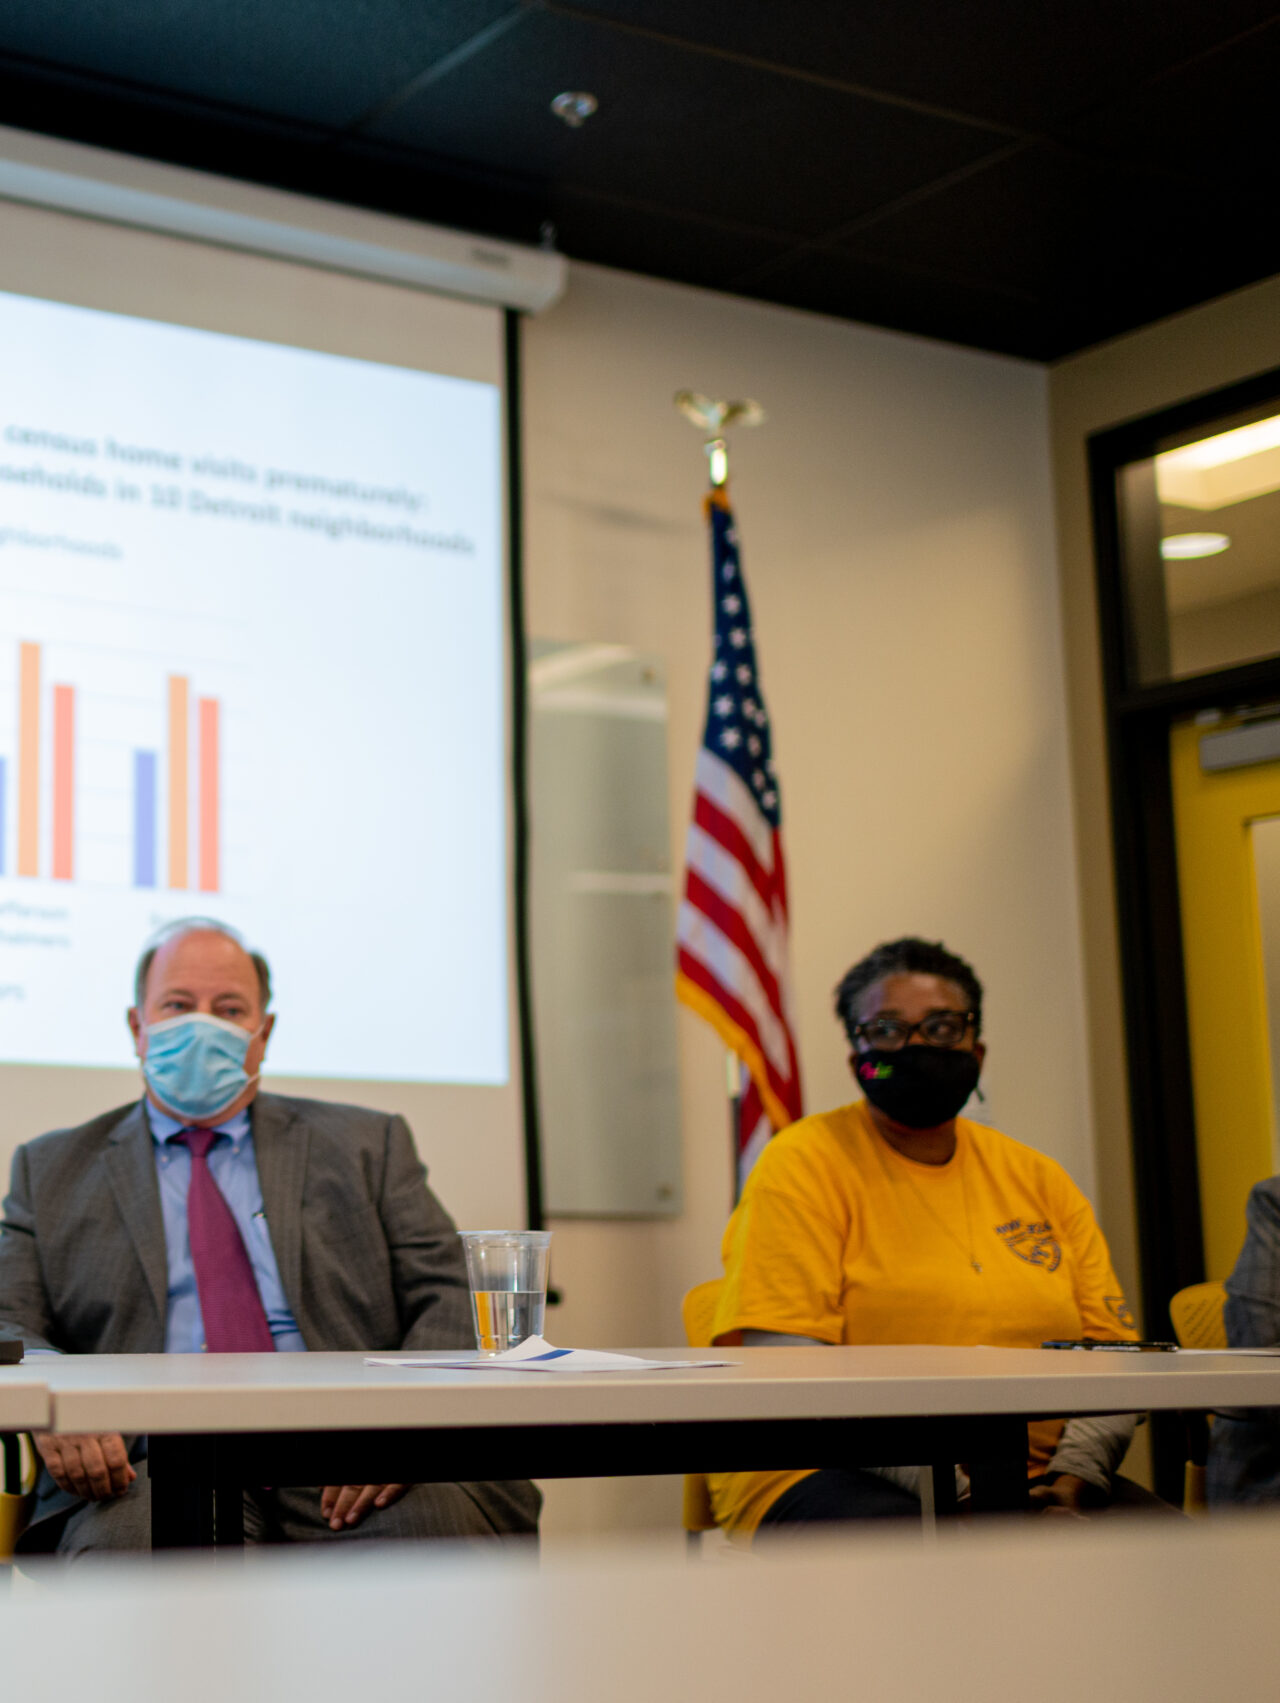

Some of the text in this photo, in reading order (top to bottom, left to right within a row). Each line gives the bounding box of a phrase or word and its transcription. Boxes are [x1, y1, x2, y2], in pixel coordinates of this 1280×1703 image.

[4, 423, 99, 458] census
[105, 437, 182, 473] home
[190, 455, 258, 485] visits
[115, 476, 142, 503] in
[187, 488, 284, 525] Detroit
